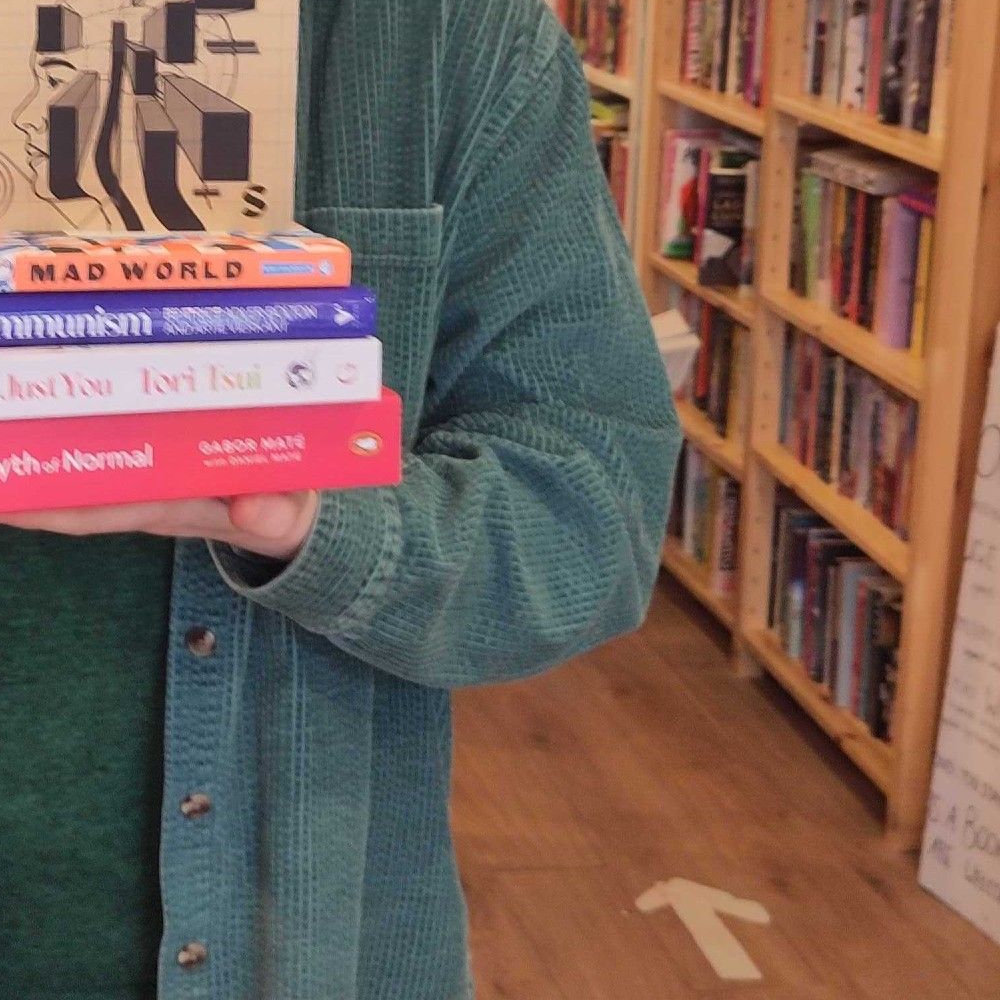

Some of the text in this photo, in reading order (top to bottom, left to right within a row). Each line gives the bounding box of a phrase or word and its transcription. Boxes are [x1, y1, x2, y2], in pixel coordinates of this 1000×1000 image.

[30, 262, 105, 283] MAD
[120, 260, 244, 281] WORLD
[60, 371, 114, 398] You
[61, 443, 154, 472] Normal
